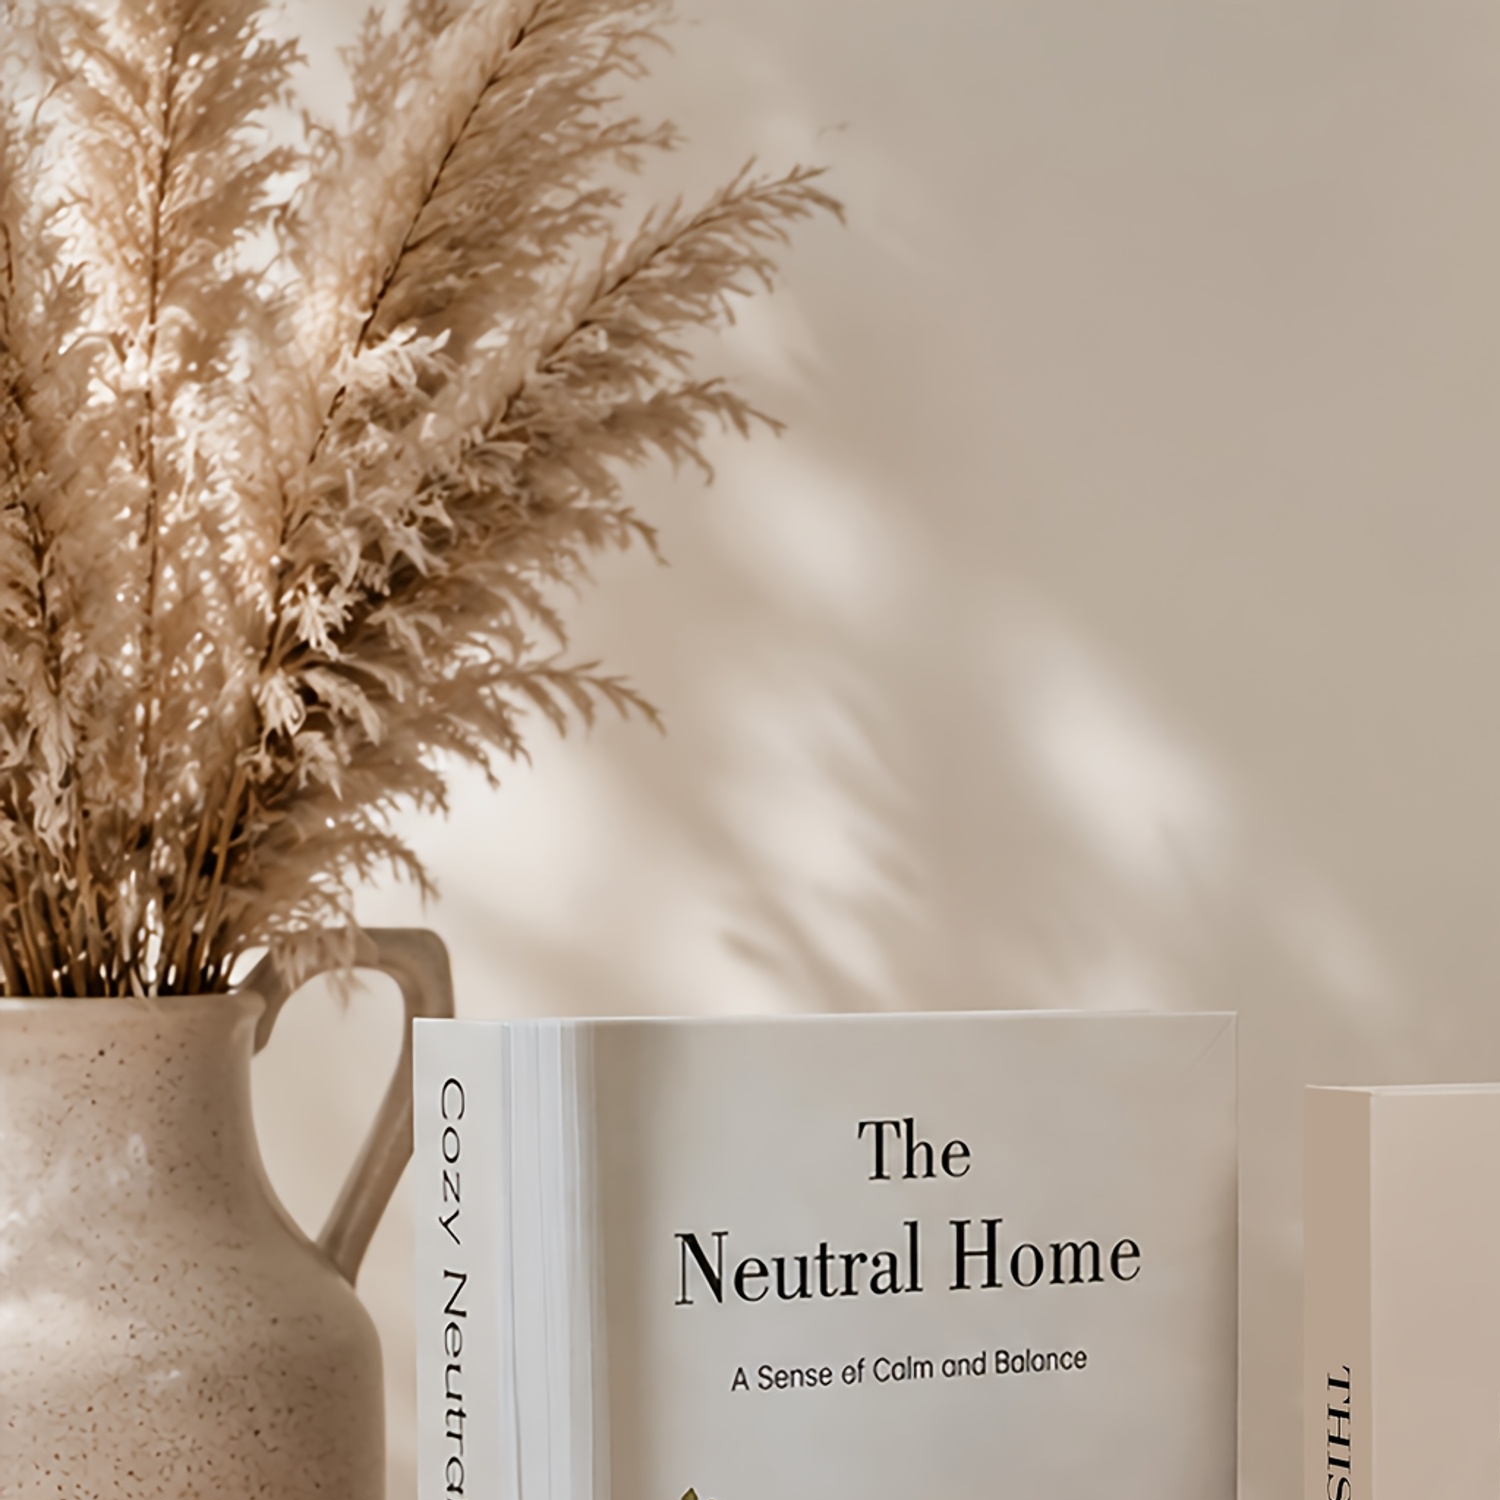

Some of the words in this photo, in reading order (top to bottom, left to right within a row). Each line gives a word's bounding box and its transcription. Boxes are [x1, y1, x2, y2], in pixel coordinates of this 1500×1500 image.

[438, 1077, 465, 1246] Cozy
[857, 1117, 971, 1181] The
[674, 1220, 924, 1306] Neutral
[948, 1218, 1141, 1291] Home
[731, 1366, 750, 1392] A
[757, 1364, 833, 1391] Sense
[872, 1355, 934, 1383] Calm
[941, 1350, 987, 1378] and
